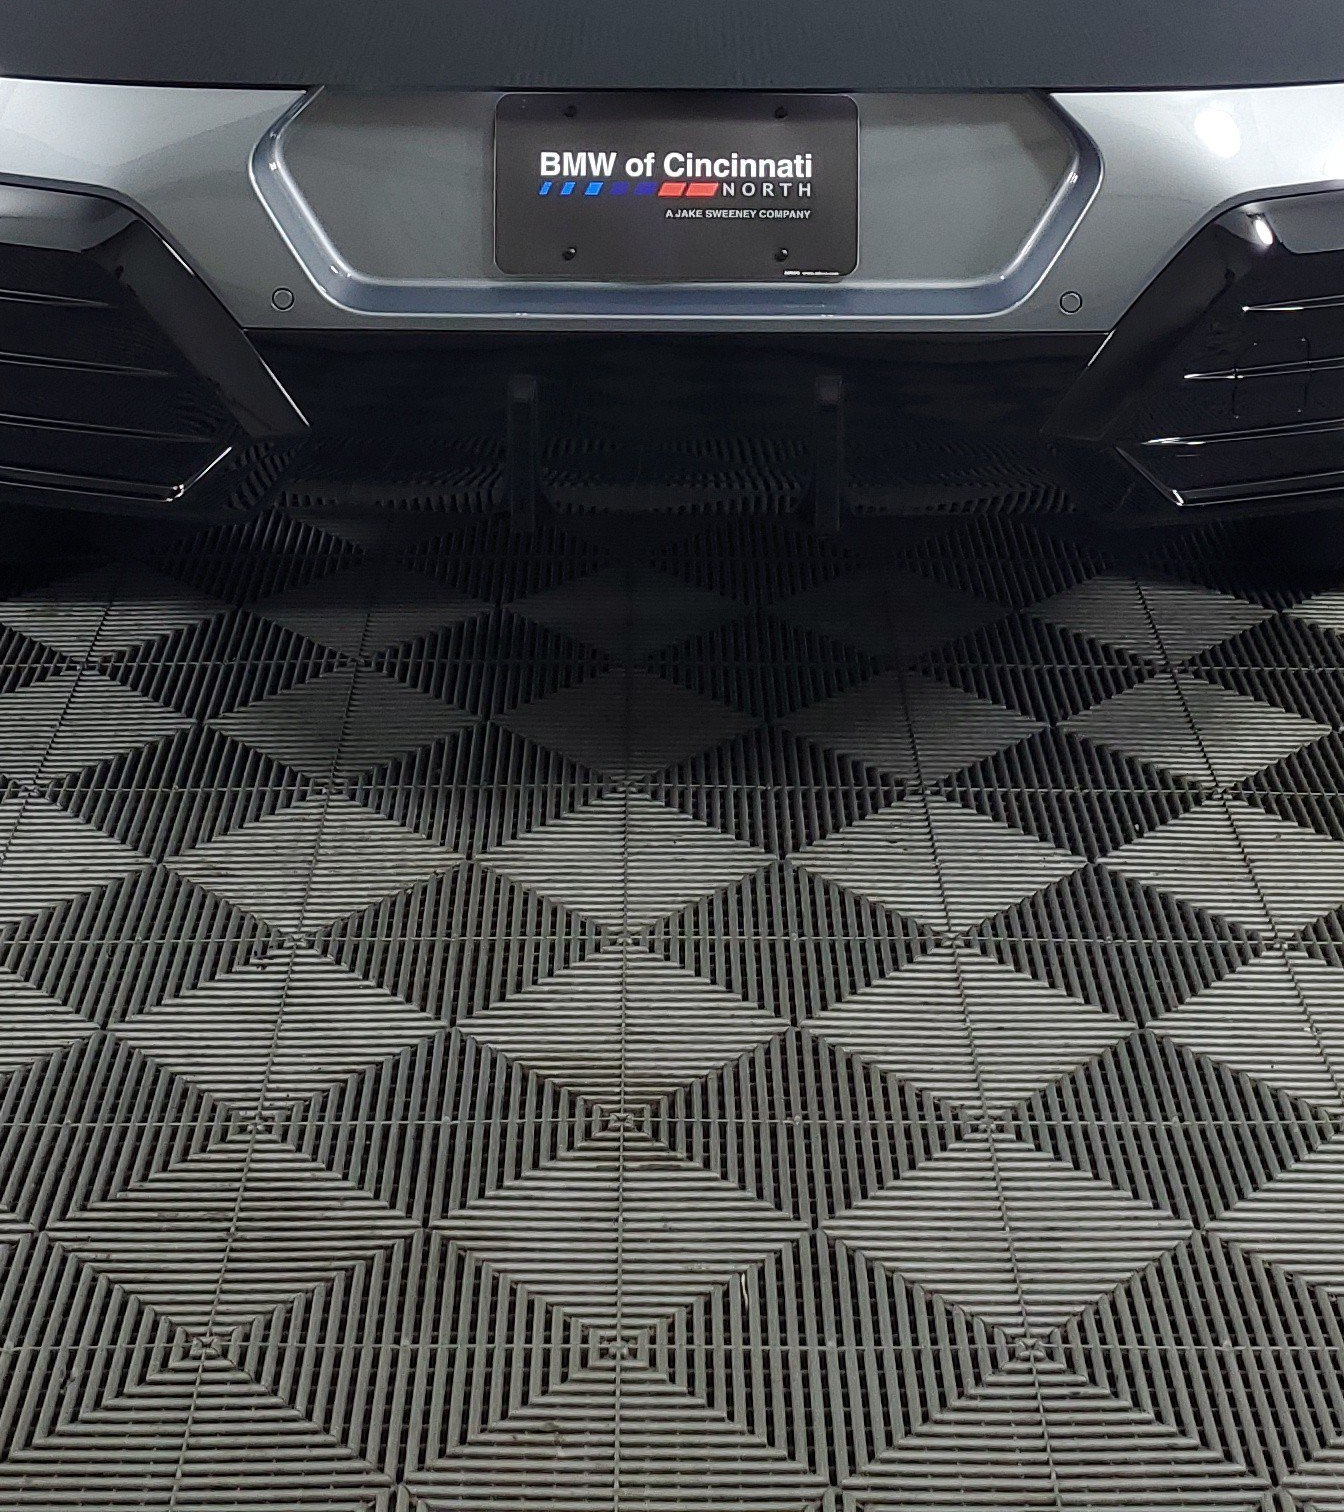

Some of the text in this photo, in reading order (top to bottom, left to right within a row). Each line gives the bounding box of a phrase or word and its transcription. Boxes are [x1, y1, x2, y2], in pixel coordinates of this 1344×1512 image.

[540, 151, 813, 178] BMW of Cincinnati
[722, 182, 811, 197] NORTH
[665, 209, 811, 219] A JAKE SWEENEY COMPANY
